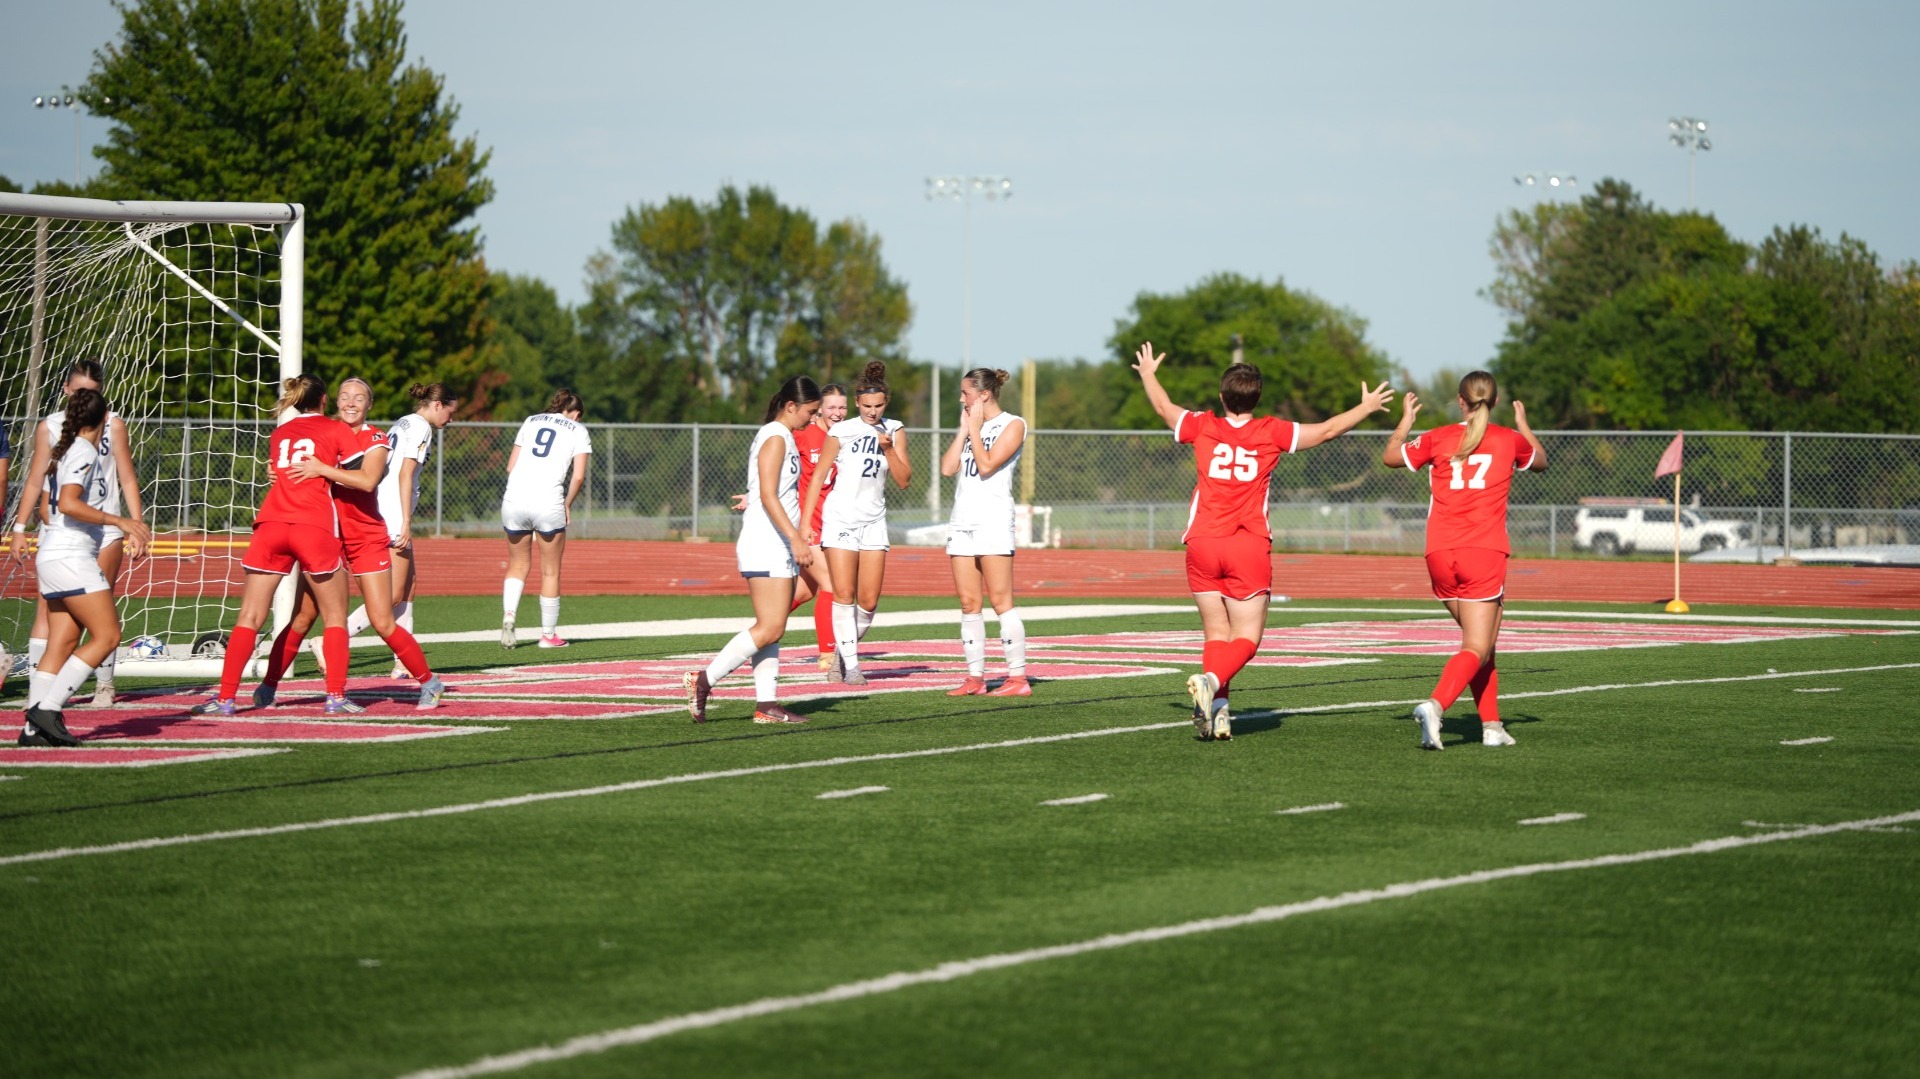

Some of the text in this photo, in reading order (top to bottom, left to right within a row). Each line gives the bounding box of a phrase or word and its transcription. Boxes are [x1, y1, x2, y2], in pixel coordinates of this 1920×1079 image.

[554, 418, 576, 432] MERCY
[277, 438, 316, 469] 12
[532, 427, 557, 458] 9
[965, 457, 979, 478] 10
[1208, 442, 1259, 482] 25
[1449, 453, 1493, 490] 17
